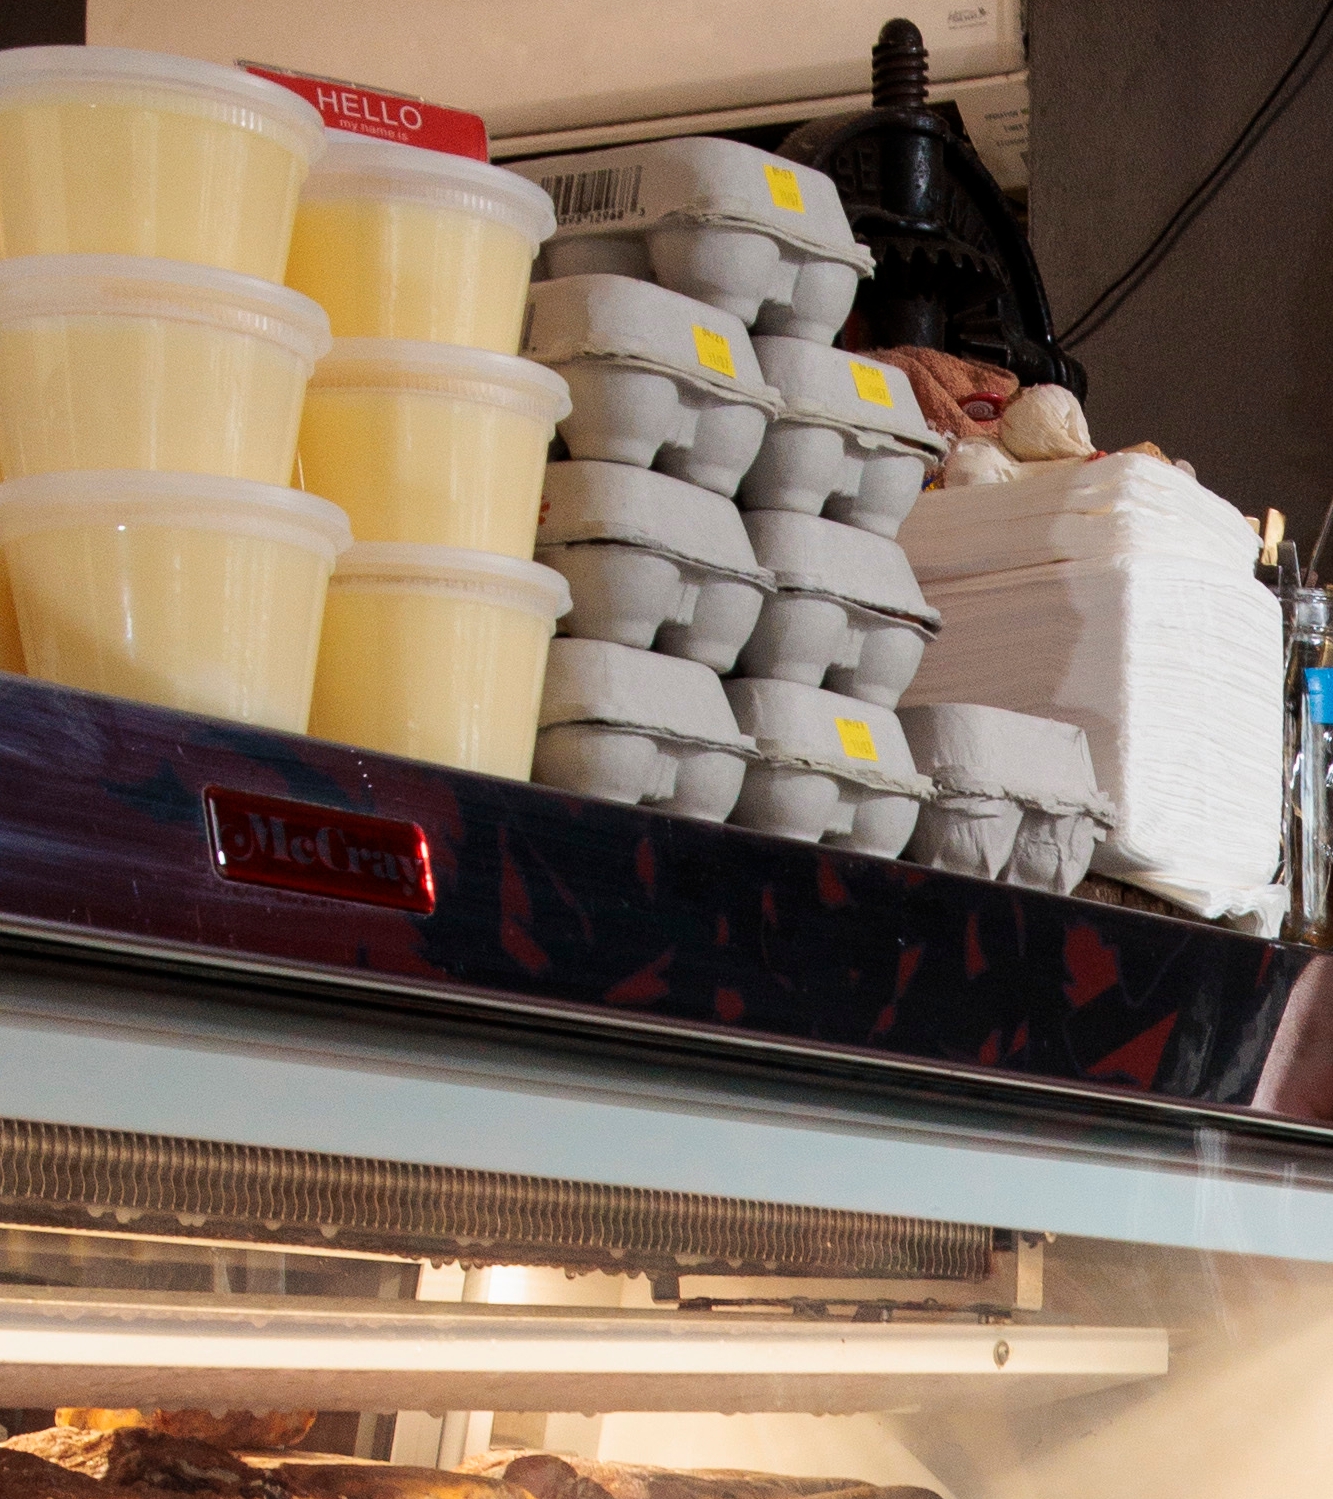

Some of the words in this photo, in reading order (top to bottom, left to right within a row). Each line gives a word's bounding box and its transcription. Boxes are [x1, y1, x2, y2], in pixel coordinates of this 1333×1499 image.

[316, 87, 423, 130] HELLO
[339, 118, 358, 134] my
[360, 123, 395, 138] name
[220, 811, 424, 897] McCray
